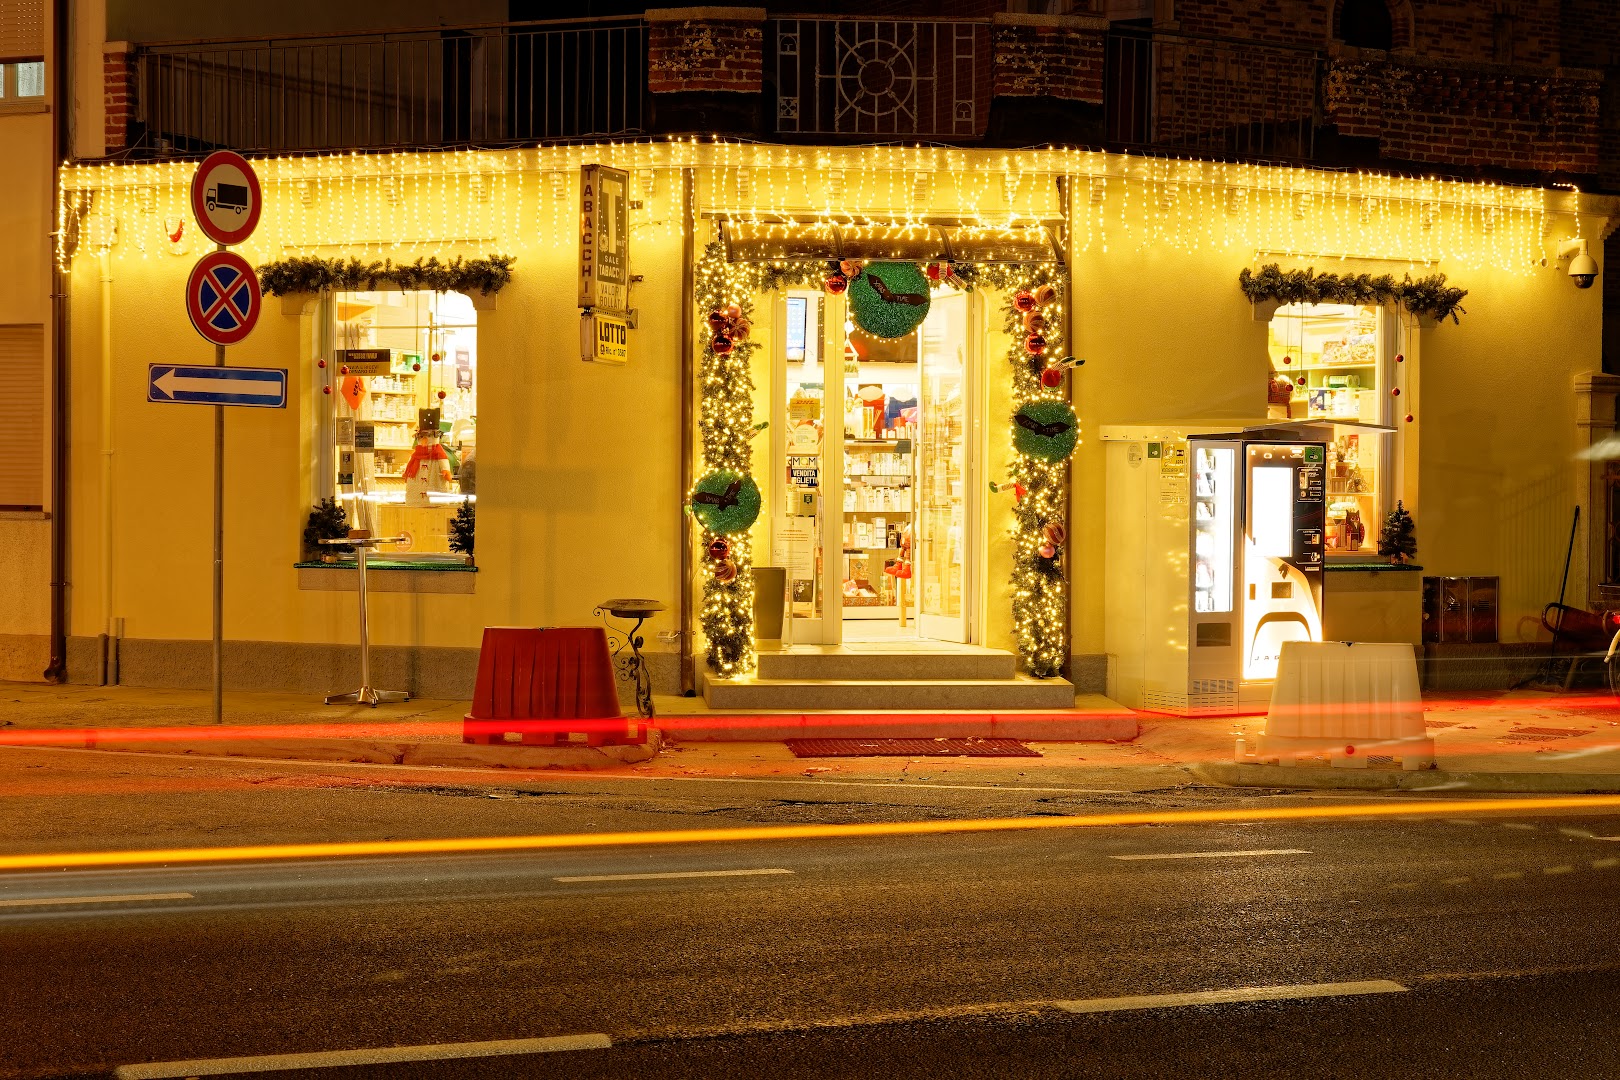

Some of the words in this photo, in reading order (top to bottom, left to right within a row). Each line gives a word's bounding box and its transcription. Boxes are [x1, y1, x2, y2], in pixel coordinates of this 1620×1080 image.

[602, 178, 623, 254] T
[582, 169, 594, 294] TABACCHI
[604, 255, 619, 265] SALE
[600, 284, 622, 298] VALORI
[599, 321, 626, 345] LOTTO
[794, 469, 816, 478] VENDITA
